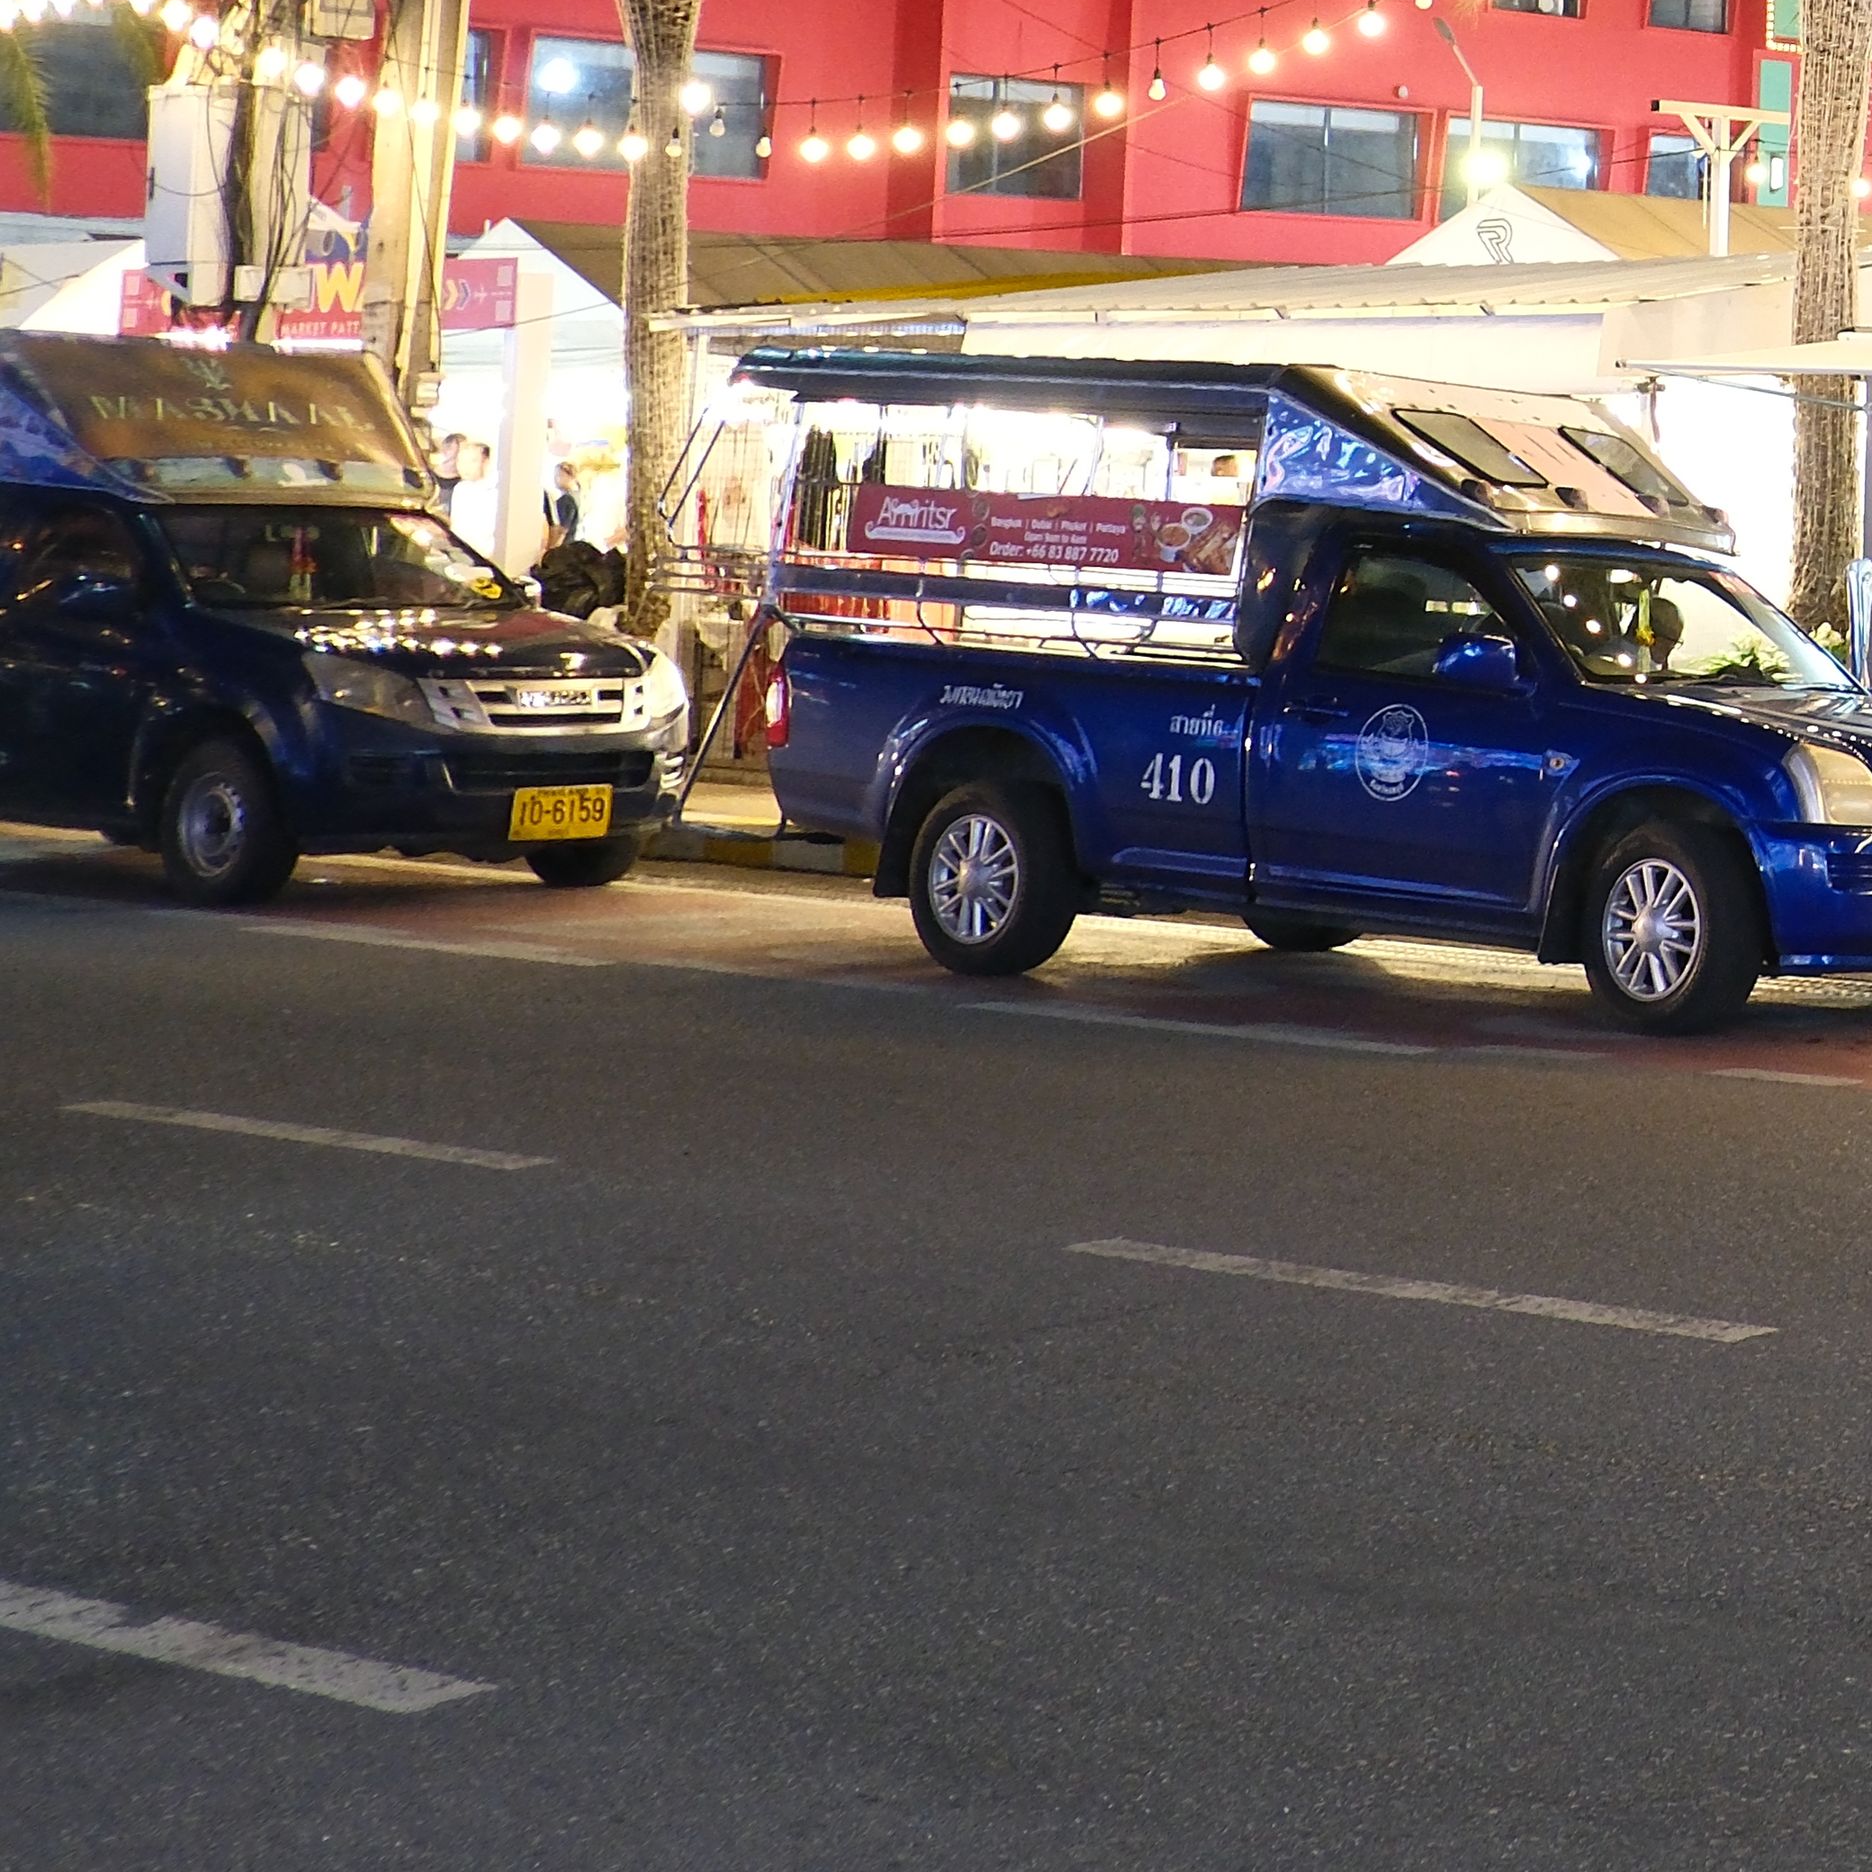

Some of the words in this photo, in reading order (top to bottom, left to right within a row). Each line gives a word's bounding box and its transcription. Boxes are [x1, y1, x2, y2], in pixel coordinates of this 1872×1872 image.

[989, 540, 1025, 558] Order:
[1047, 545, 1063, 560] 83
[1064, 546, 1088, 562] 887
[1089, 547, 1120, 564] 7720
[1141, 752, 1215, 805] 410
[519, 797, 606, 827] 10-6159
